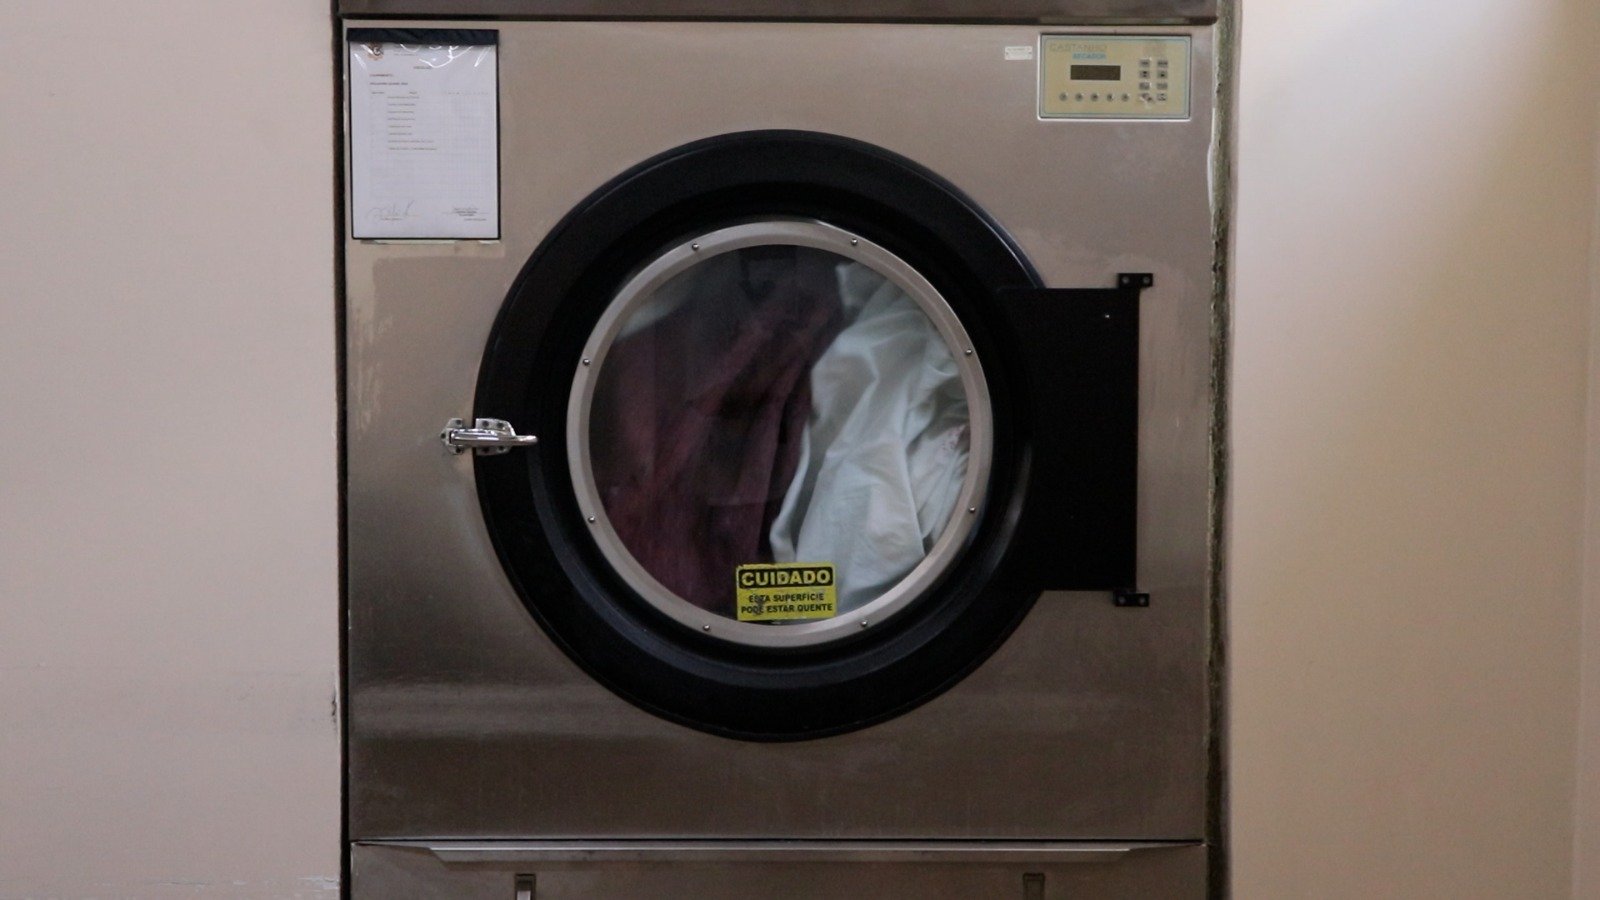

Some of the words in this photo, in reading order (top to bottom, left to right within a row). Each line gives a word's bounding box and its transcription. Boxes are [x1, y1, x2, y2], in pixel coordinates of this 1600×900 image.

[741, 569, 831, 586] CUIDADO
[748, 594, 771, 603] ESTA
[741, 604, 764, 614] PODE
[766, 604, 795, 613] ESTAR
[797, 603, 833, 612] QUENTE
